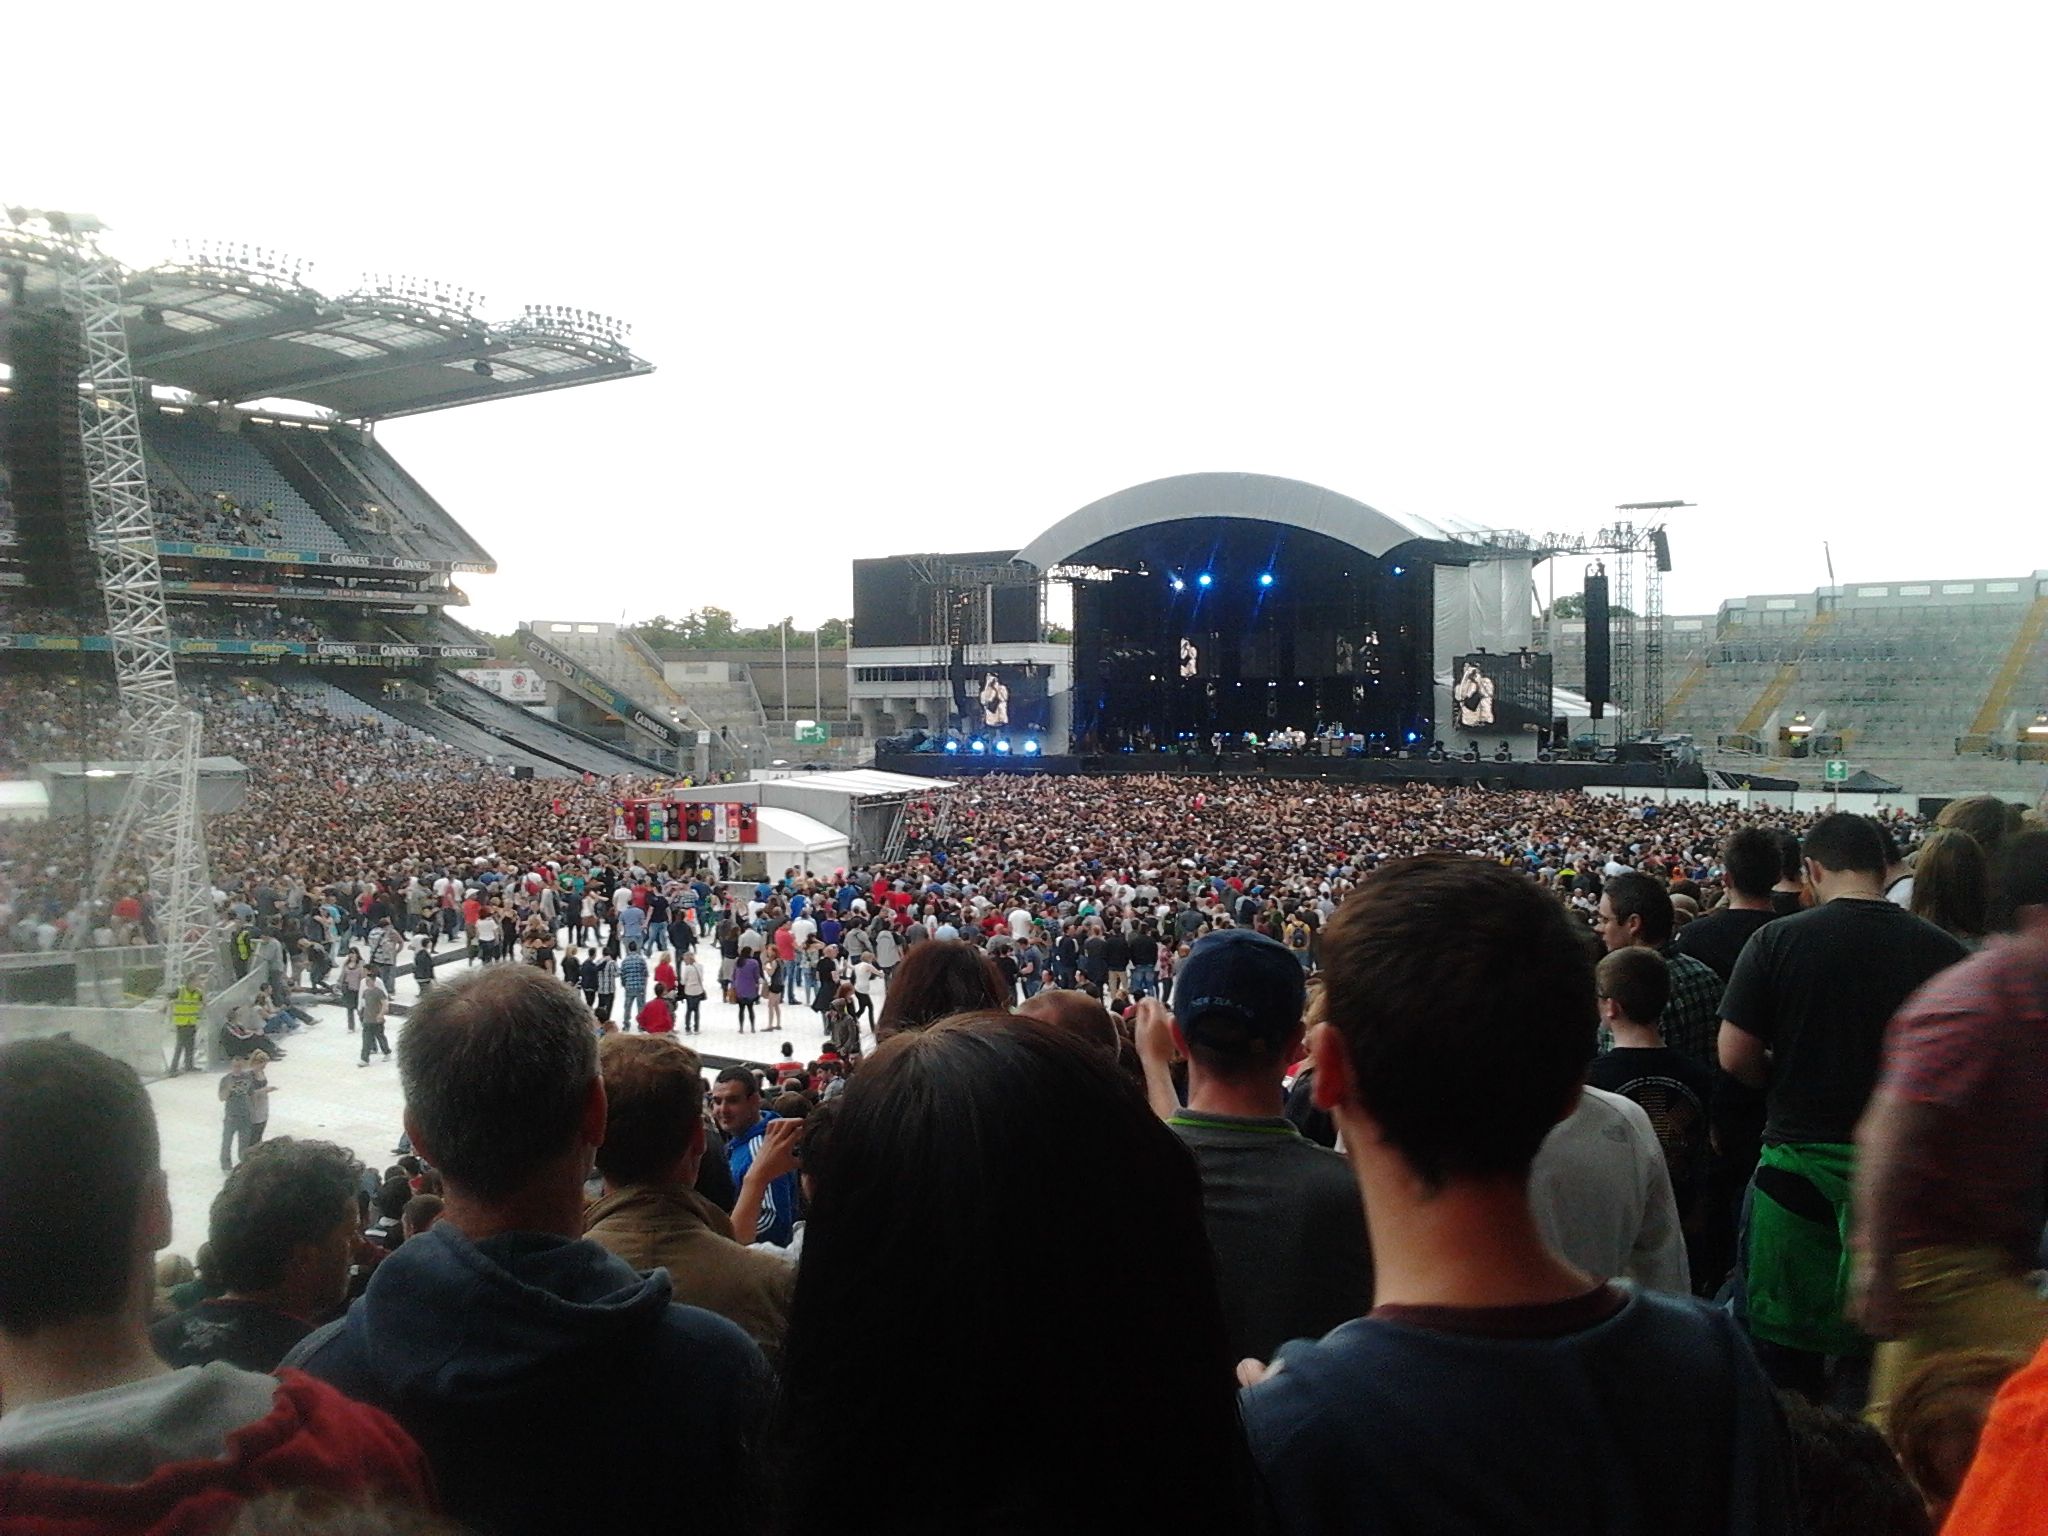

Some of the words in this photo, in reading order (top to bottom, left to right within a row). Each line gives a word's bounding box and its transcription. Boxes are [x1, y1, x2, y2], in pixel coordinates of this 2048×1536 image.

[330, 553, 370, 566] GUINNESS
[393, 556, 431, 570] GUINNESS
[451, 560, 488, 572] GUINNESS
[318, 643, 356, 655] GUINNESS
[380, 644, 419, 657] GUINNESS
[440, 646, 478, 657] GUINNESS
[528, 642, 574, 676] ETIHAD
[635, 711, 669, 739] GUINNESS
